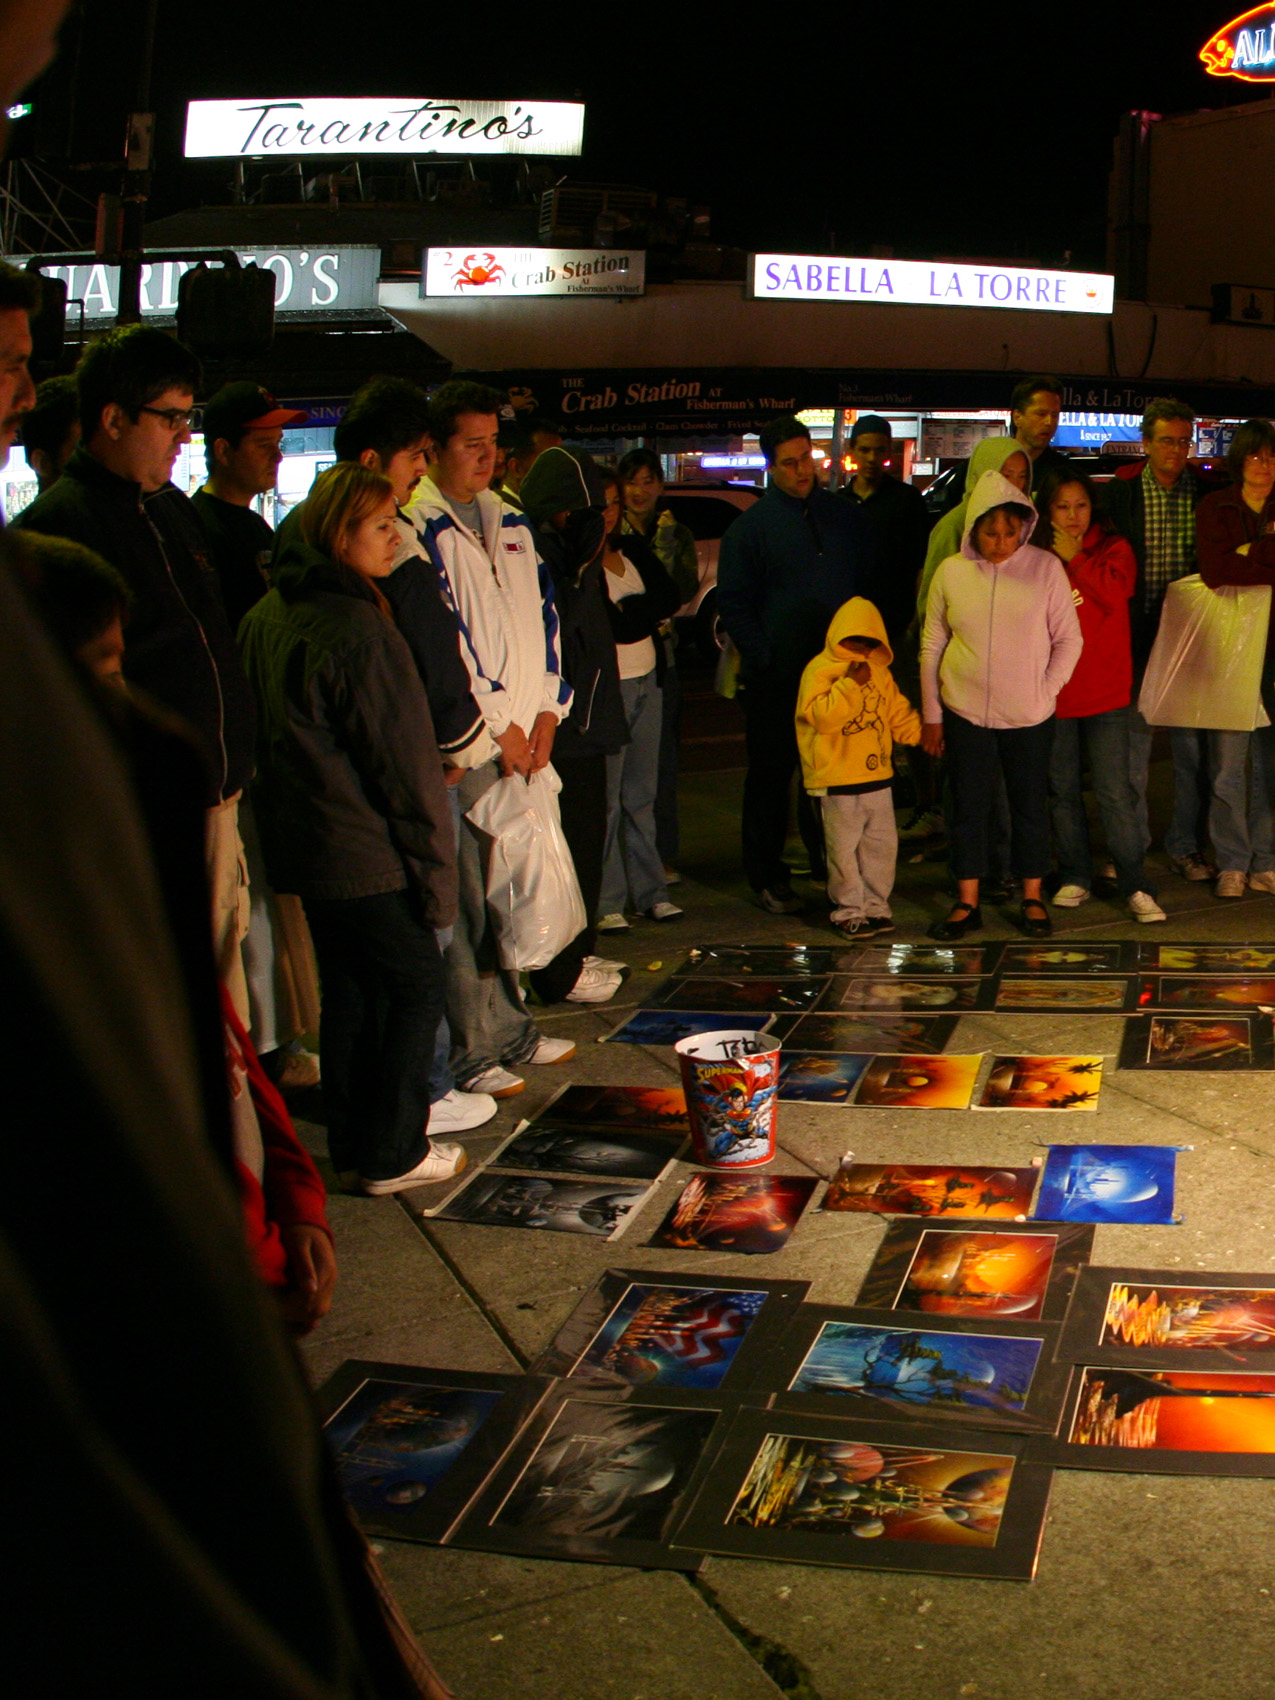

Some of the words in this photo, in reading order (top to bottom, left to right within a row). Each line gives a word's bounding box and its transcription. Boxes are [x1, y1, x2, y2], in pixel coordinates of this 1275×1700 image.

[236, 102, 543, 153] Tarantino's
[511, 266, 556, 289] Crab
[562, 256, 630, 280] Station
[567, 285, 614, 293] Fisherman's
[616, 285, 641, 293] Wharf
[765, 262, 894, 295] SABELLA
[929, 271, 963, 298] LA
[974, 273, 1067, 304] TORRE
[561, 378, 584, 388] THE
[561, 387, 618, 414] Crab
[625, 377, 701, 406] Station
[708, 387, 723, 397] AT
[686, 399, 755, 411] Fisherman's
[759, 398, 797, 409] Wharf
[574, 425, 608, 433] Seafood
[681, 421, 719, 431] Chowder
[1105, 445, 1144, 454] ENTRANC
